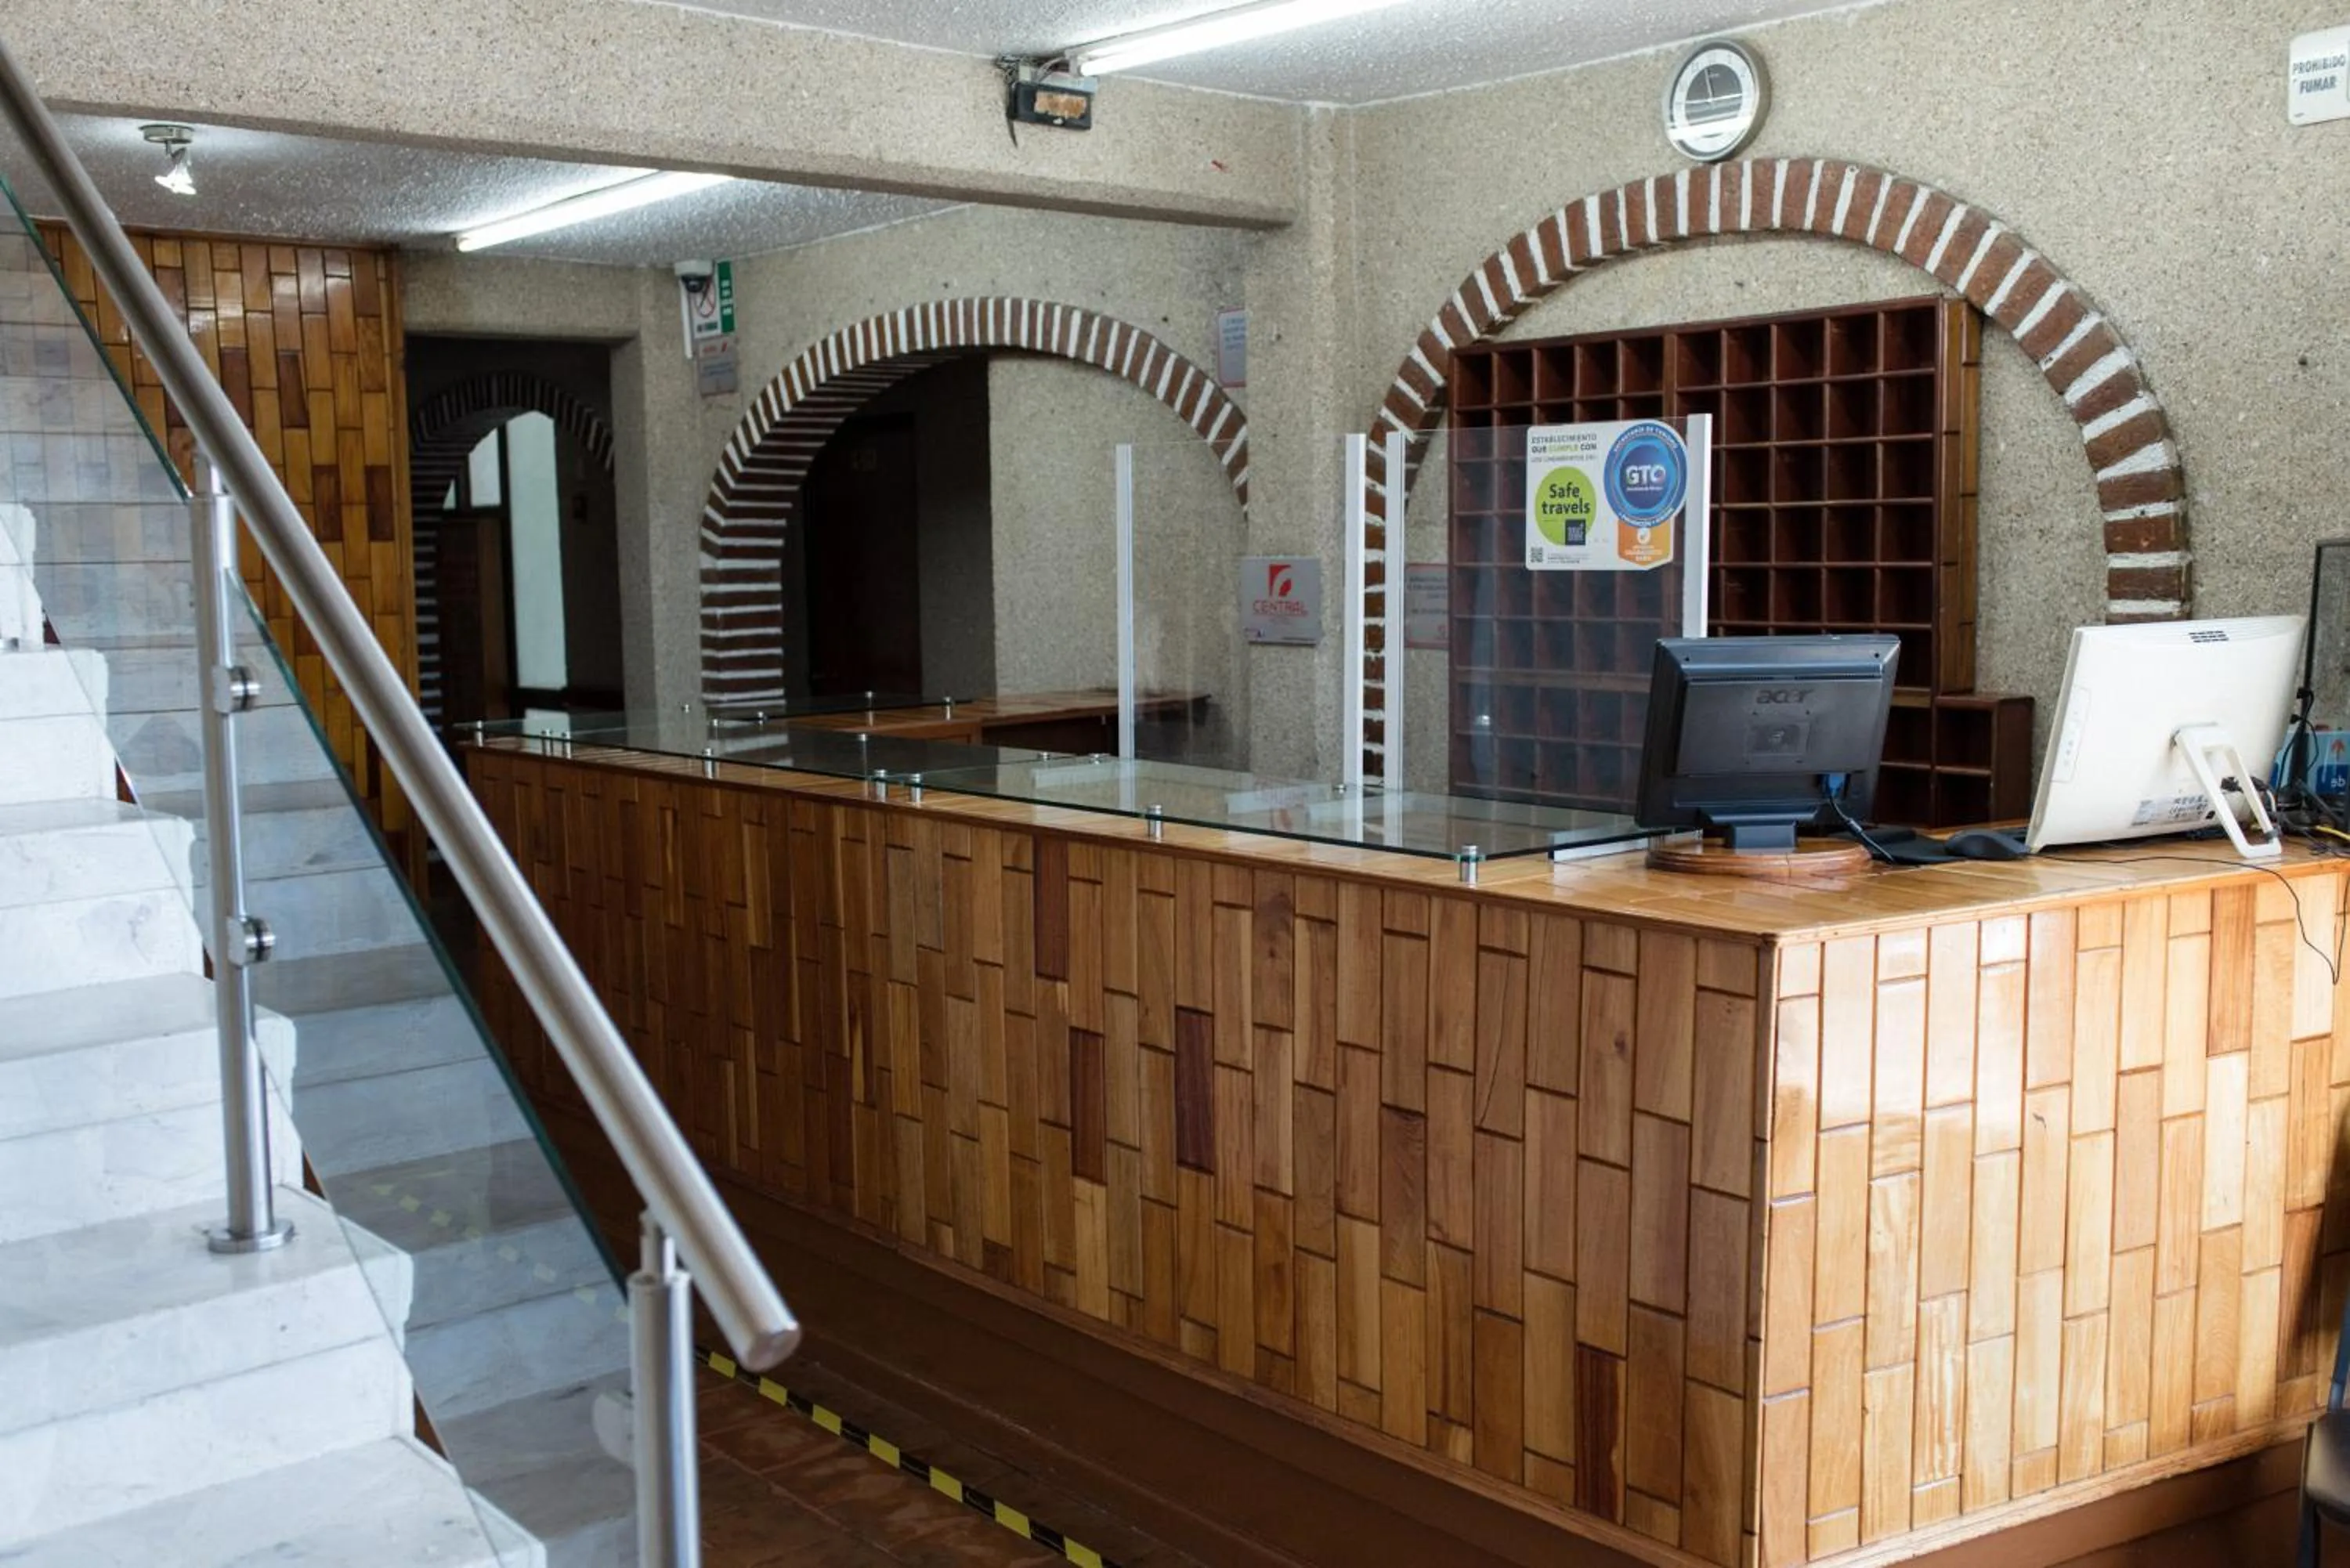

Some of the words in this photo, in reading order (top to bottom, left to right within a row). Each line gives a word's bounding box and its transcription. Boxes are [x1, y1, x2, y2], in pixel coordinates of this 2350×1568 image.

[2292, 54, 2345, 74] PROHIBIDO
[2299, 76, 2337, 94] FUMAR
[1531, 433, 1597, 444] ESTABLECIMIENTO
[1625, 465, 1666, 485] GTO
[1549, 482, 1580, 499] Safe
[1541, 498, 1591, 515] travels
[1253, 599, 1309, 616] CENTRAL
[1756, 688, 1815, 705] acer
